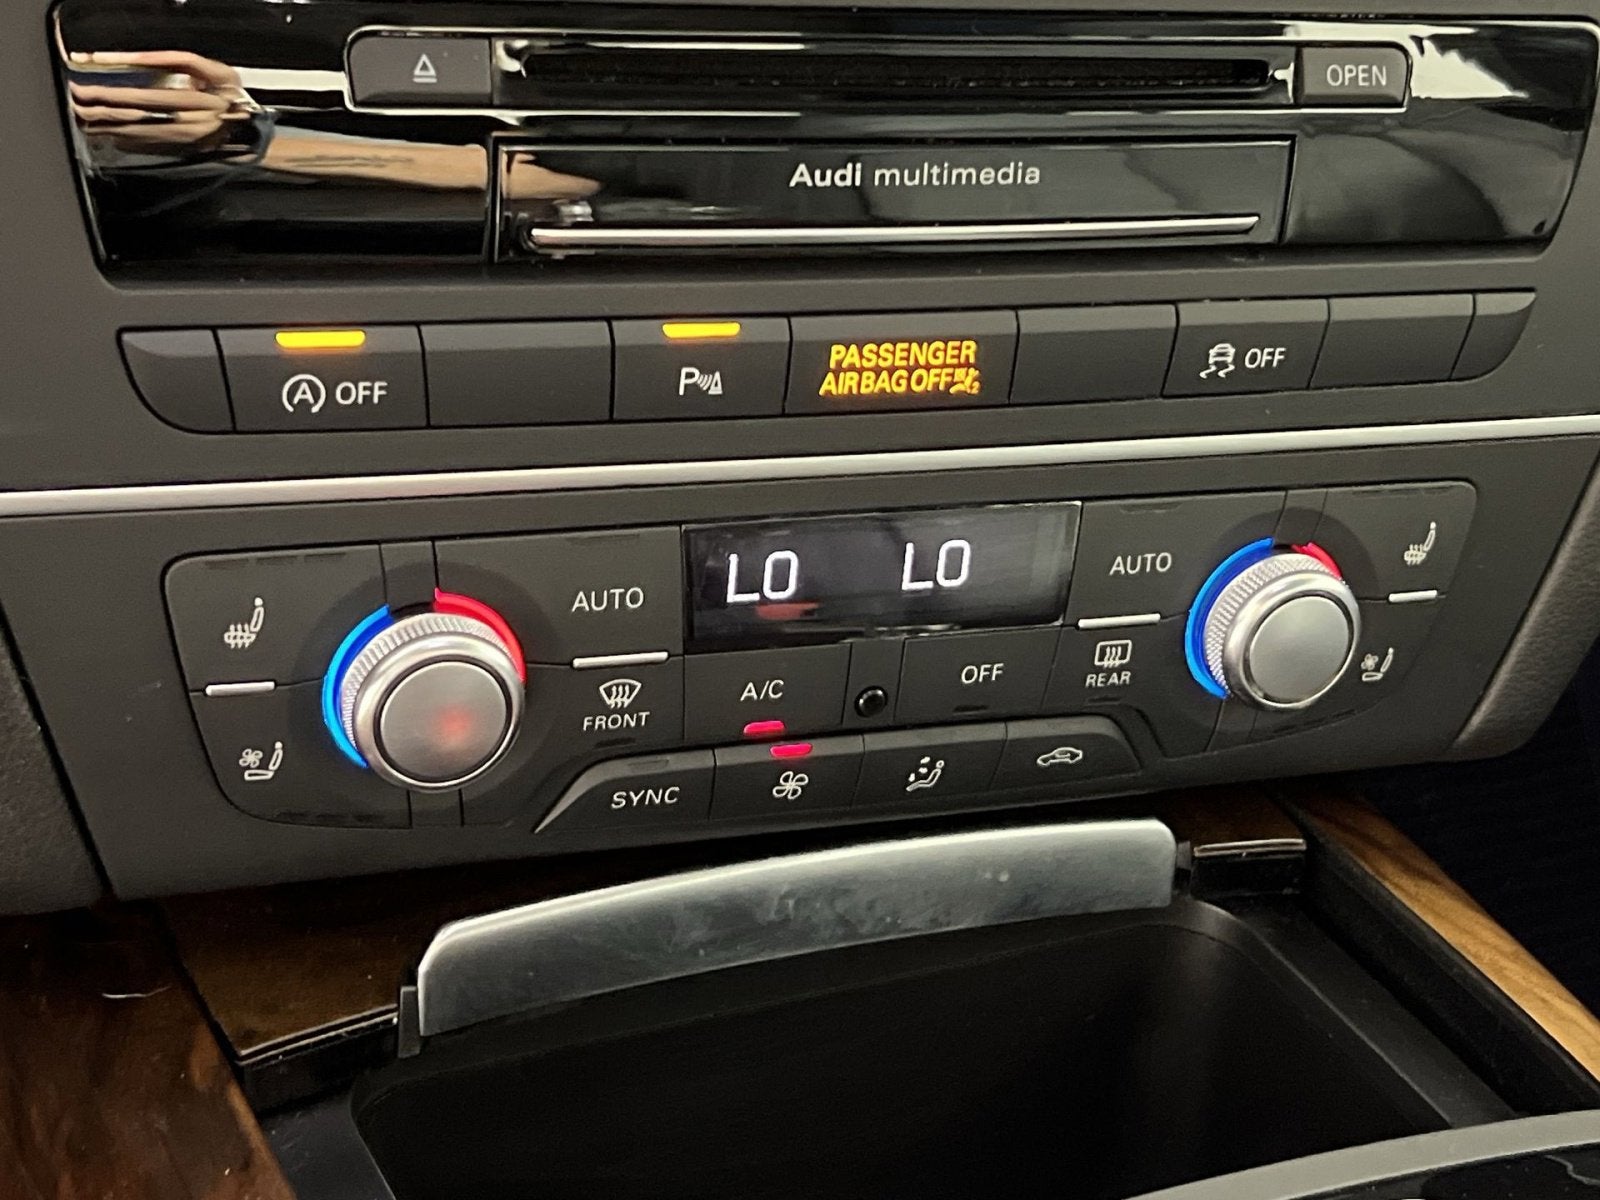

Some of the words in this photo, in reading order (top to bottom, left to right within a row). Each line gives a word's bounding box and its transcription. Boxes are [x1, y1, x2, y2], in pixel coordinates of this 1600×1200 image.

[1326, 64, 1388, 88] OPEN
[790, 162, 863, 189] Audi
[873, 161, 1042, 188] multimedia
[829, 340, 978, 369] PASSENGER
[1244, 346, 1287, 369] OFF
[335, 381, 388, 405] OFF
[818, 369, 909, 397] AIRBAG
[910, 367, 955, 393] OFF
[726, 550, 799, 602] LO
[902, 539, 971, 591] LO
[1109, 552, 1172, 575] AUTO
[571, 587, 644, 611] AUTO
[961, 662, 1004, 684] OFF
[1085, 671, 1131, 687] REAR
[740, 678, 784, 702] A/C
[583, 712, 649, 731] FRONT
[611, 786, 680, 809] SYNC
